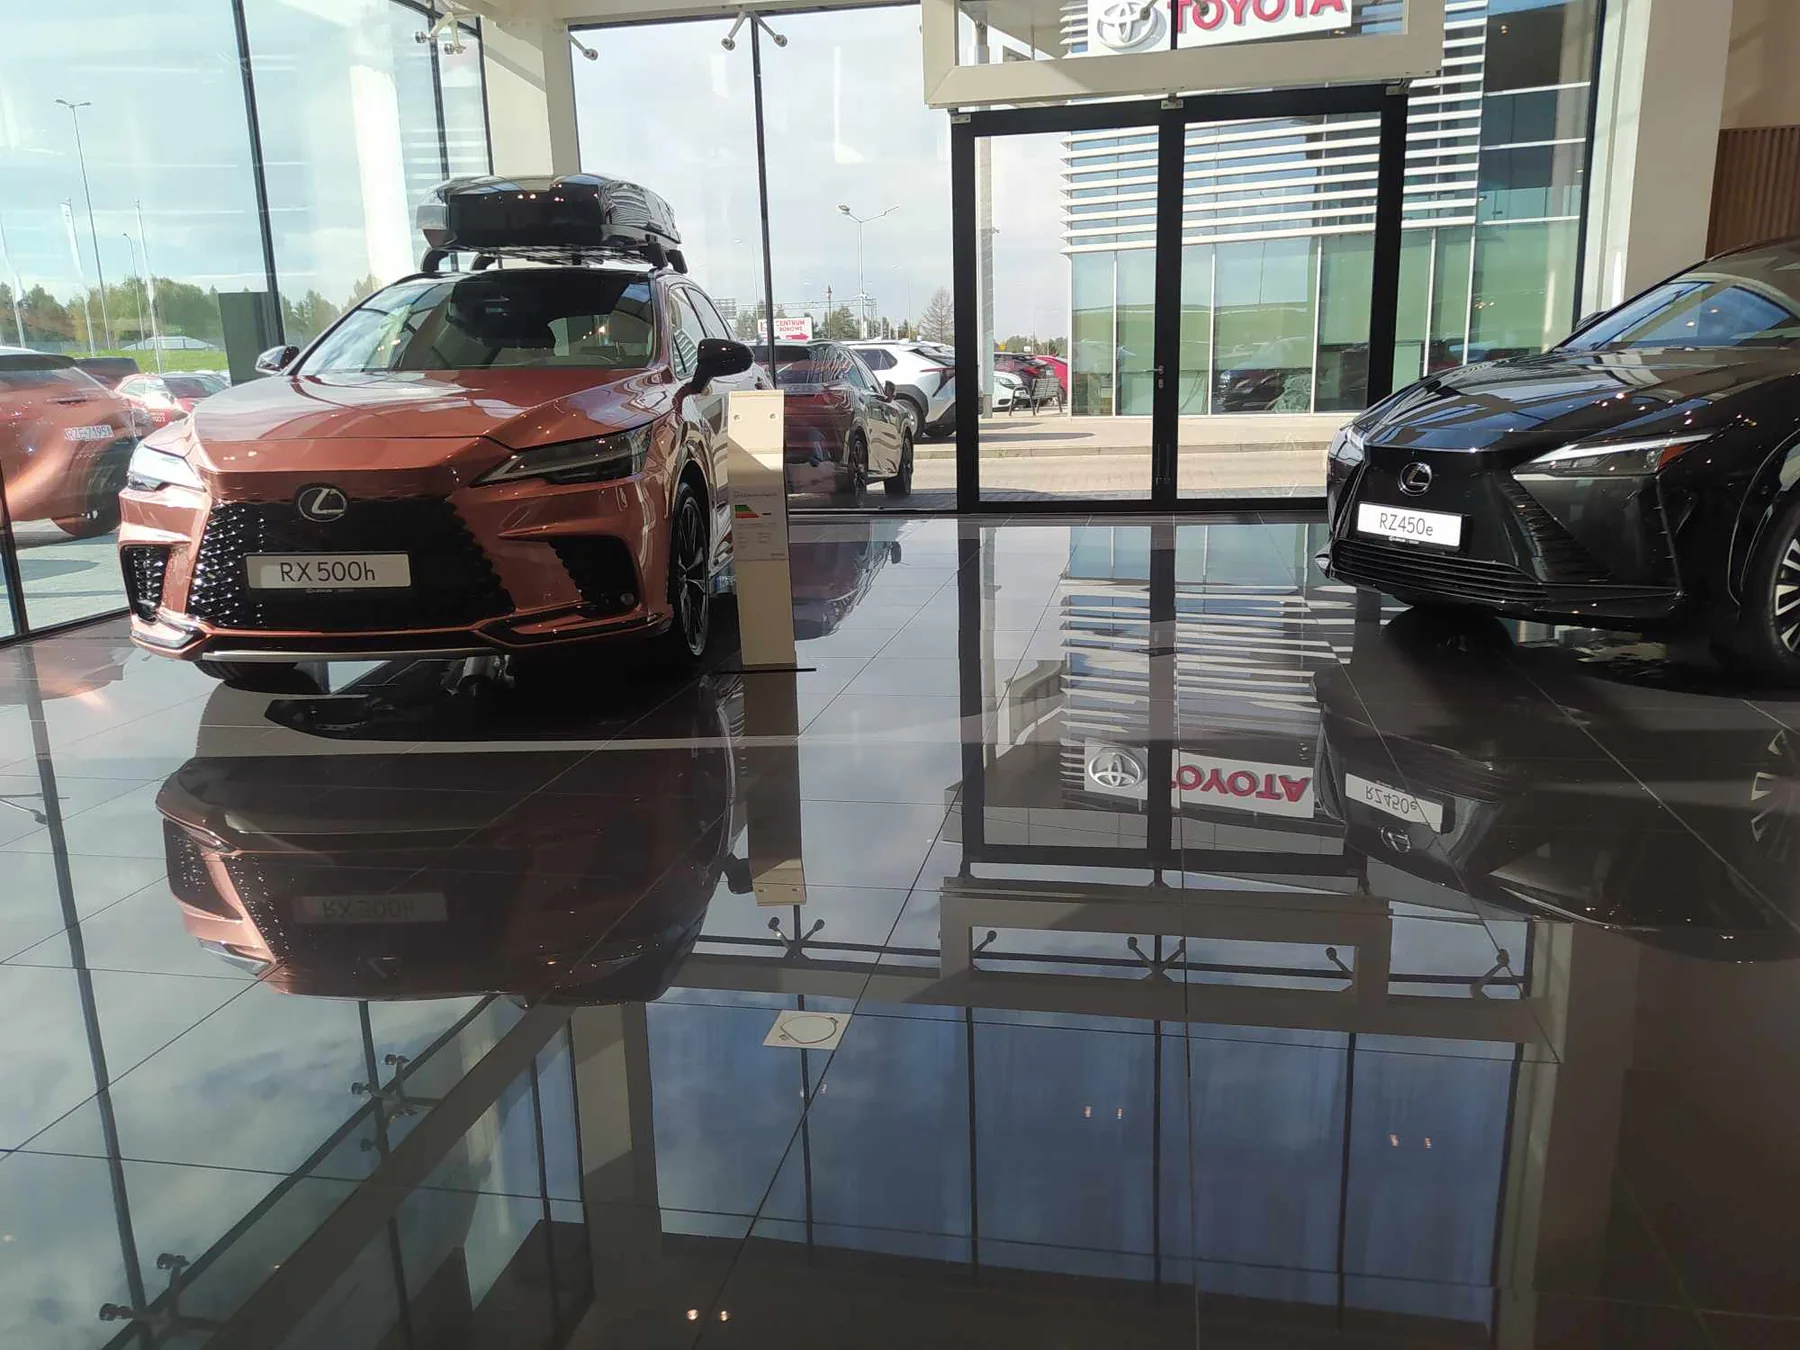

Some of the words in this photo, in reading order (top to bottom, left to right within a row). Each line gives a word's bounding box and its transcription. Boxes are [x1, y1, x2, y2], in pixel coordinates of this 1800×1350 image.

[775, 319, 805, 327] CENTRUM
[1379, 512, 1434, 536] RZ450e
[280, 562, 313, 582] RX
[317, 561, 376, 582] 500h
